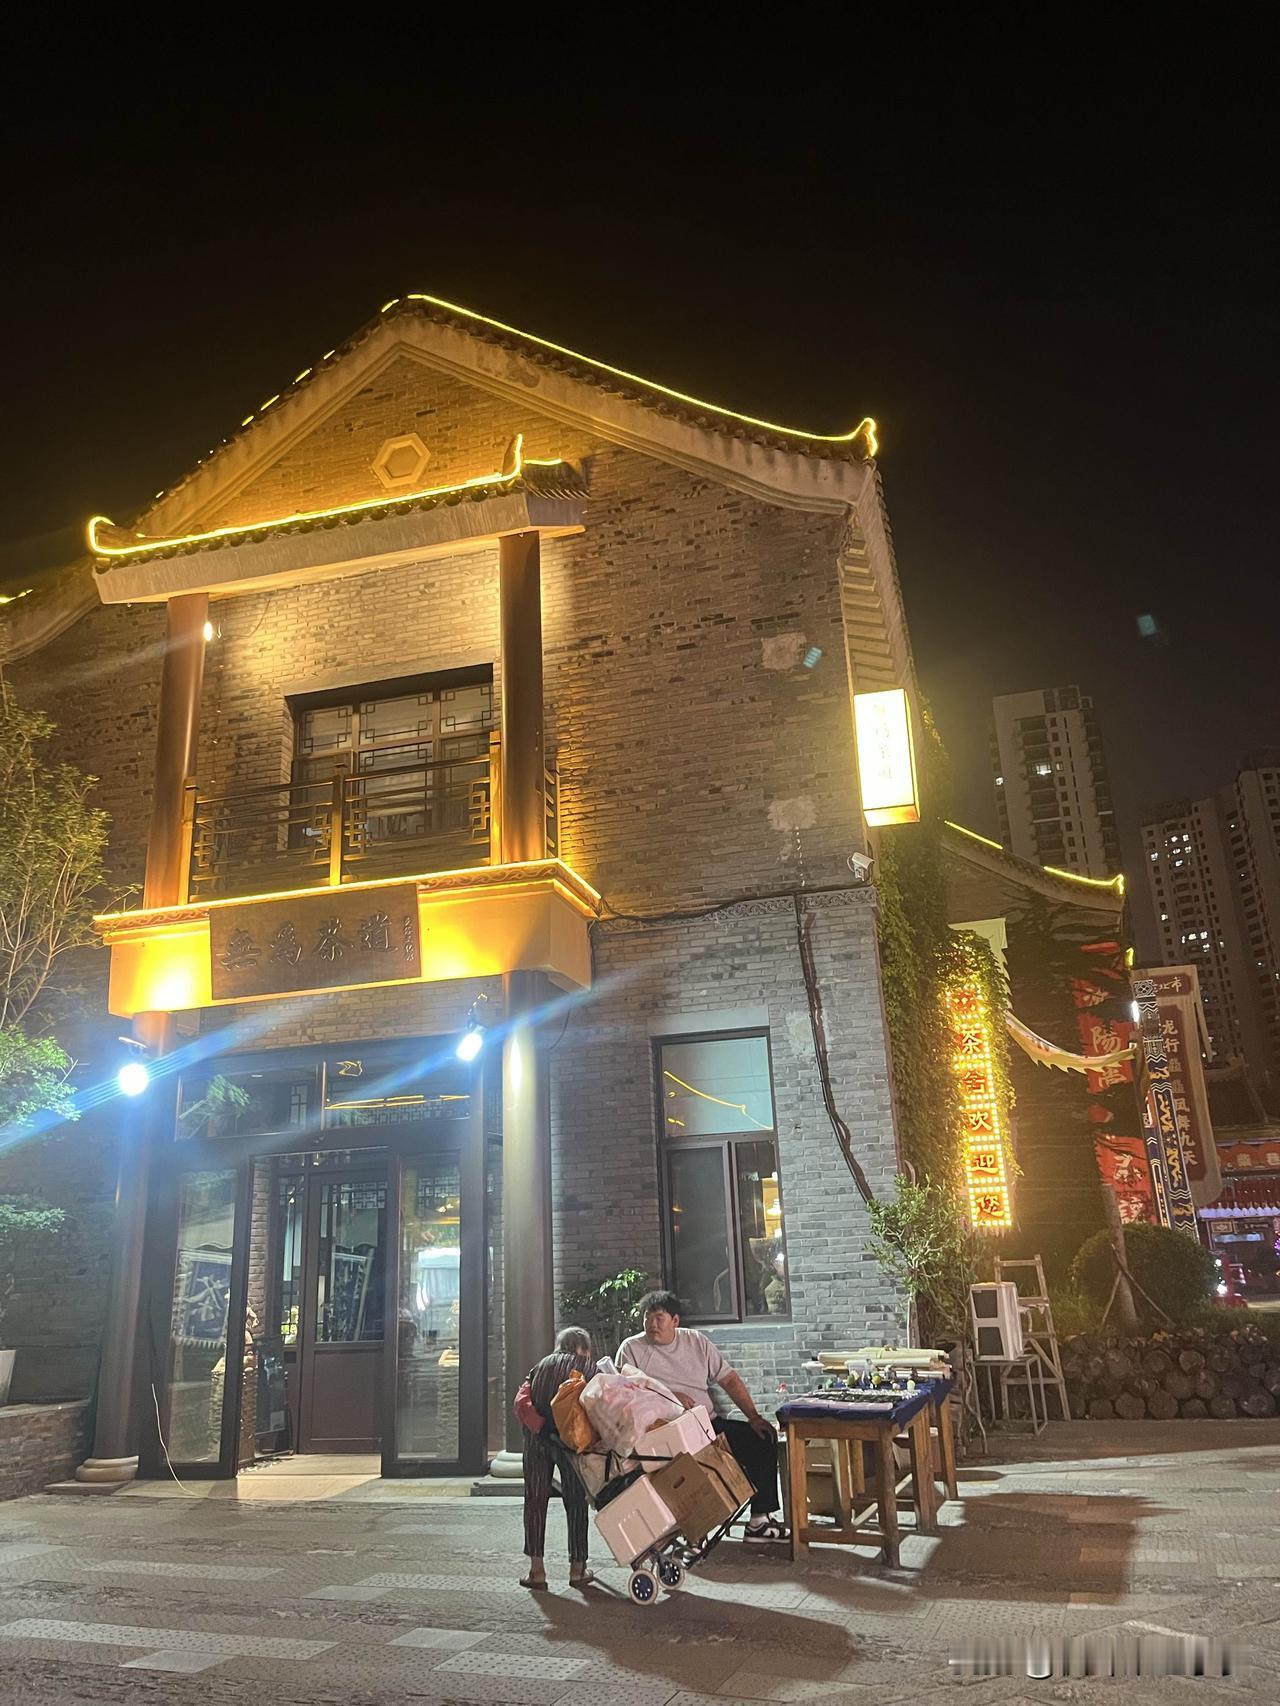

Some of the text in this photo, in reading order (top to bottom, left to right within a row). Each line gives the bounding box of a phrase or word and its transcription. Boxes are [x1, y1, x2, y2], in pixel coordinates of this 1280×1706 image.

[953, 990, 1005, 1218] 茶舍欢迎您
